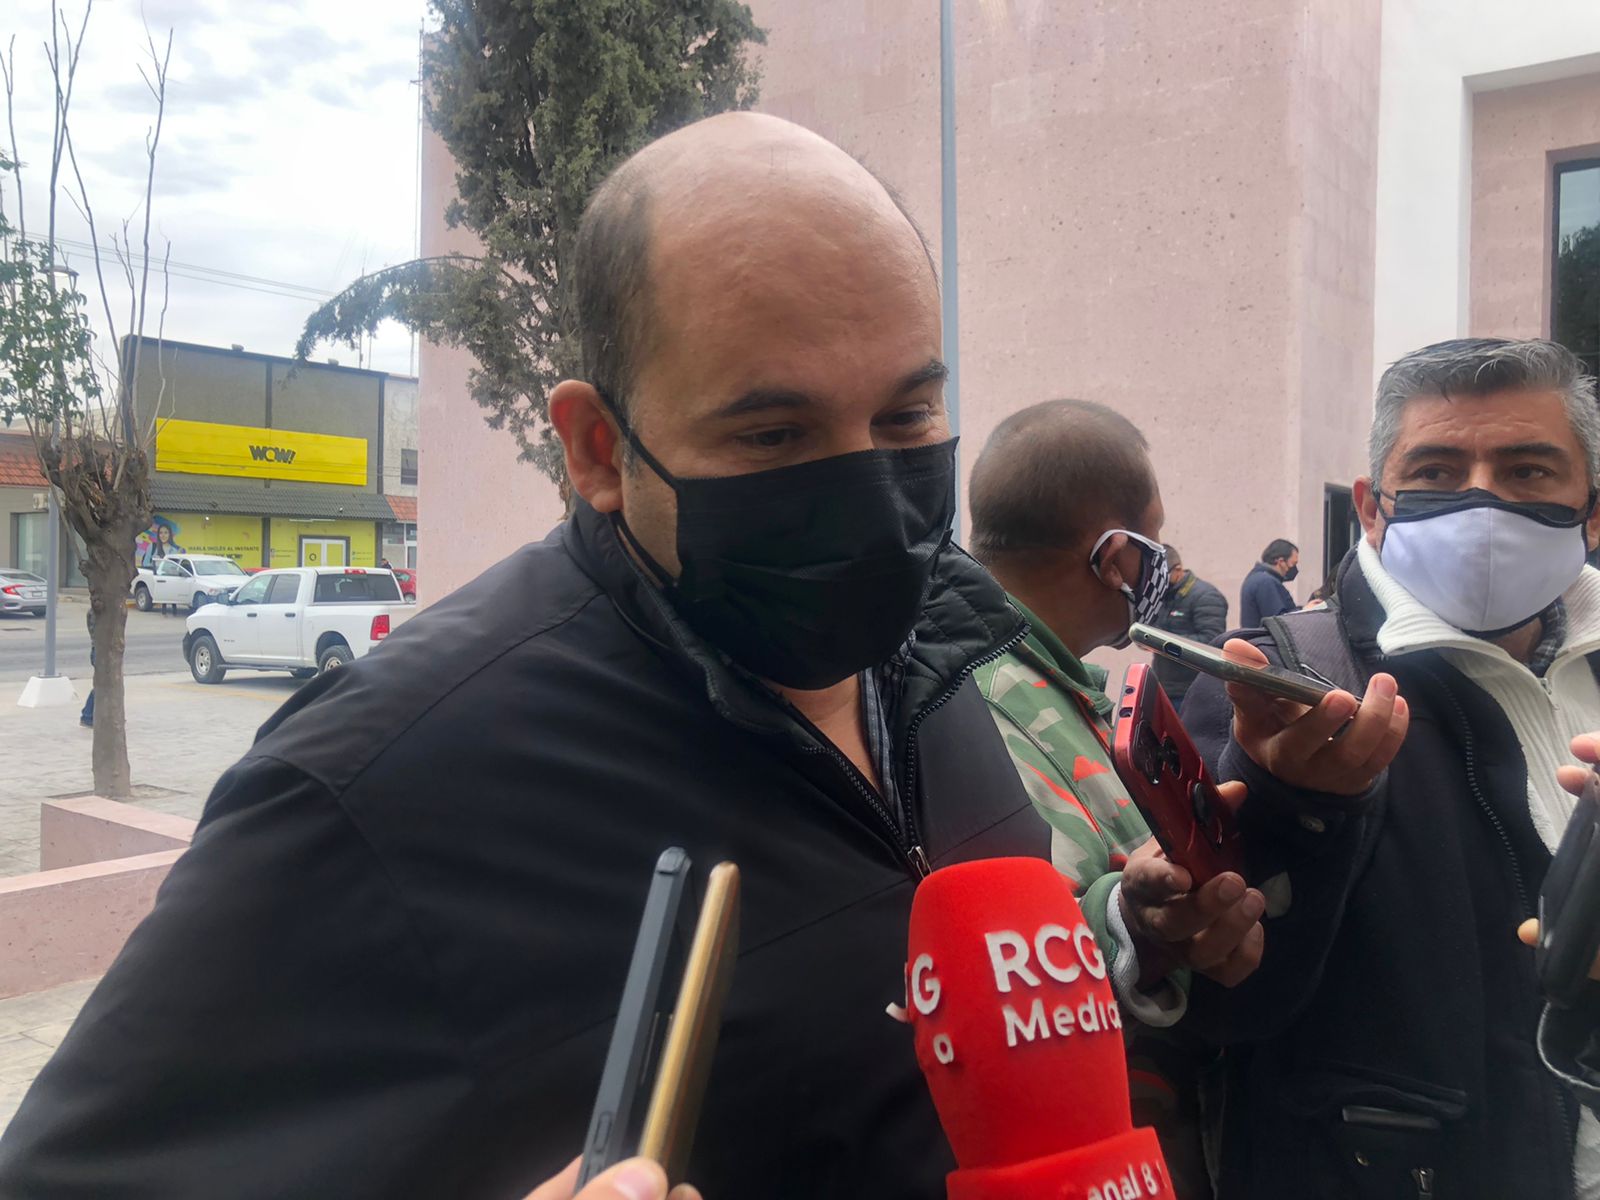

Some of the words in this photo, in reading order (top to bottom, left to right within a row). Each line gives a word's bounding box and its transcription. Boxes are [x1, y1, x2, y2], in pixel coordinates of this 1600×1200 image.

[248, 445, 297, 465] WOW!
[984, 923, 1107, 993] RCG
[1001, 992, 1122, 1048] Media
[1087, 1163, 1142, 1200] anal
